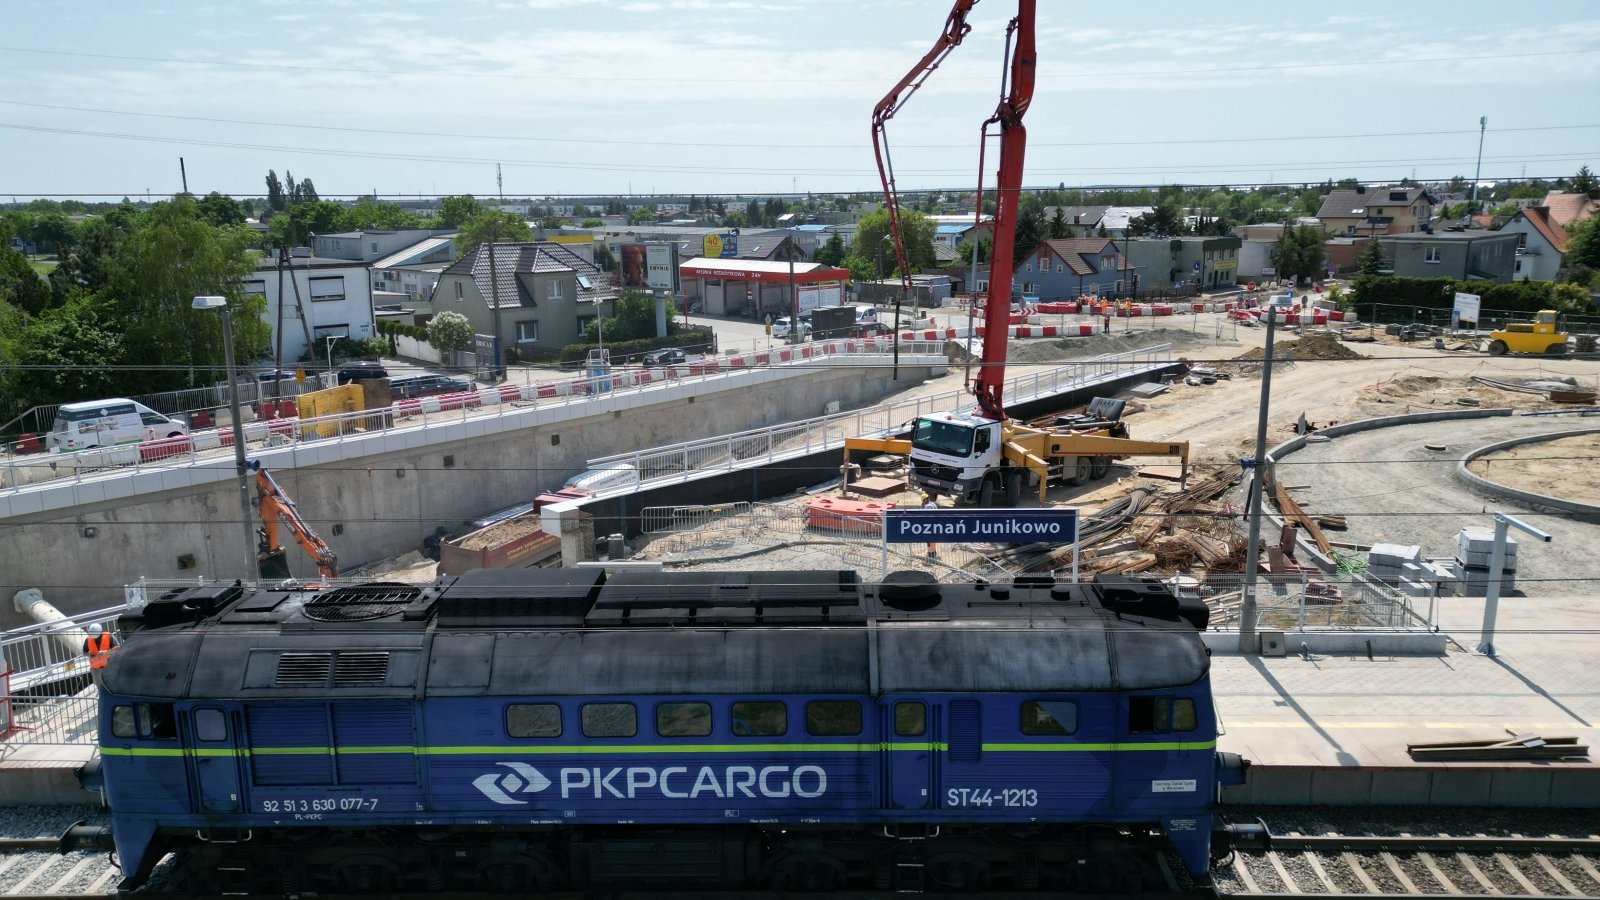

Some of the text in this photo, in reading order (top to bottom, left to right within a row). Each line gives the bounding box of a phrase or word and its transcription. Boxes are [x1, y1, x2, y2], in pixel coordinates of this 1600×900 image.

[900, 519, 1061, 534] Poznań Junikowo
[263, 798, 378, 812] 92 51 3 630 077-7
[947, 788, 1038, 807] ST44-1213
